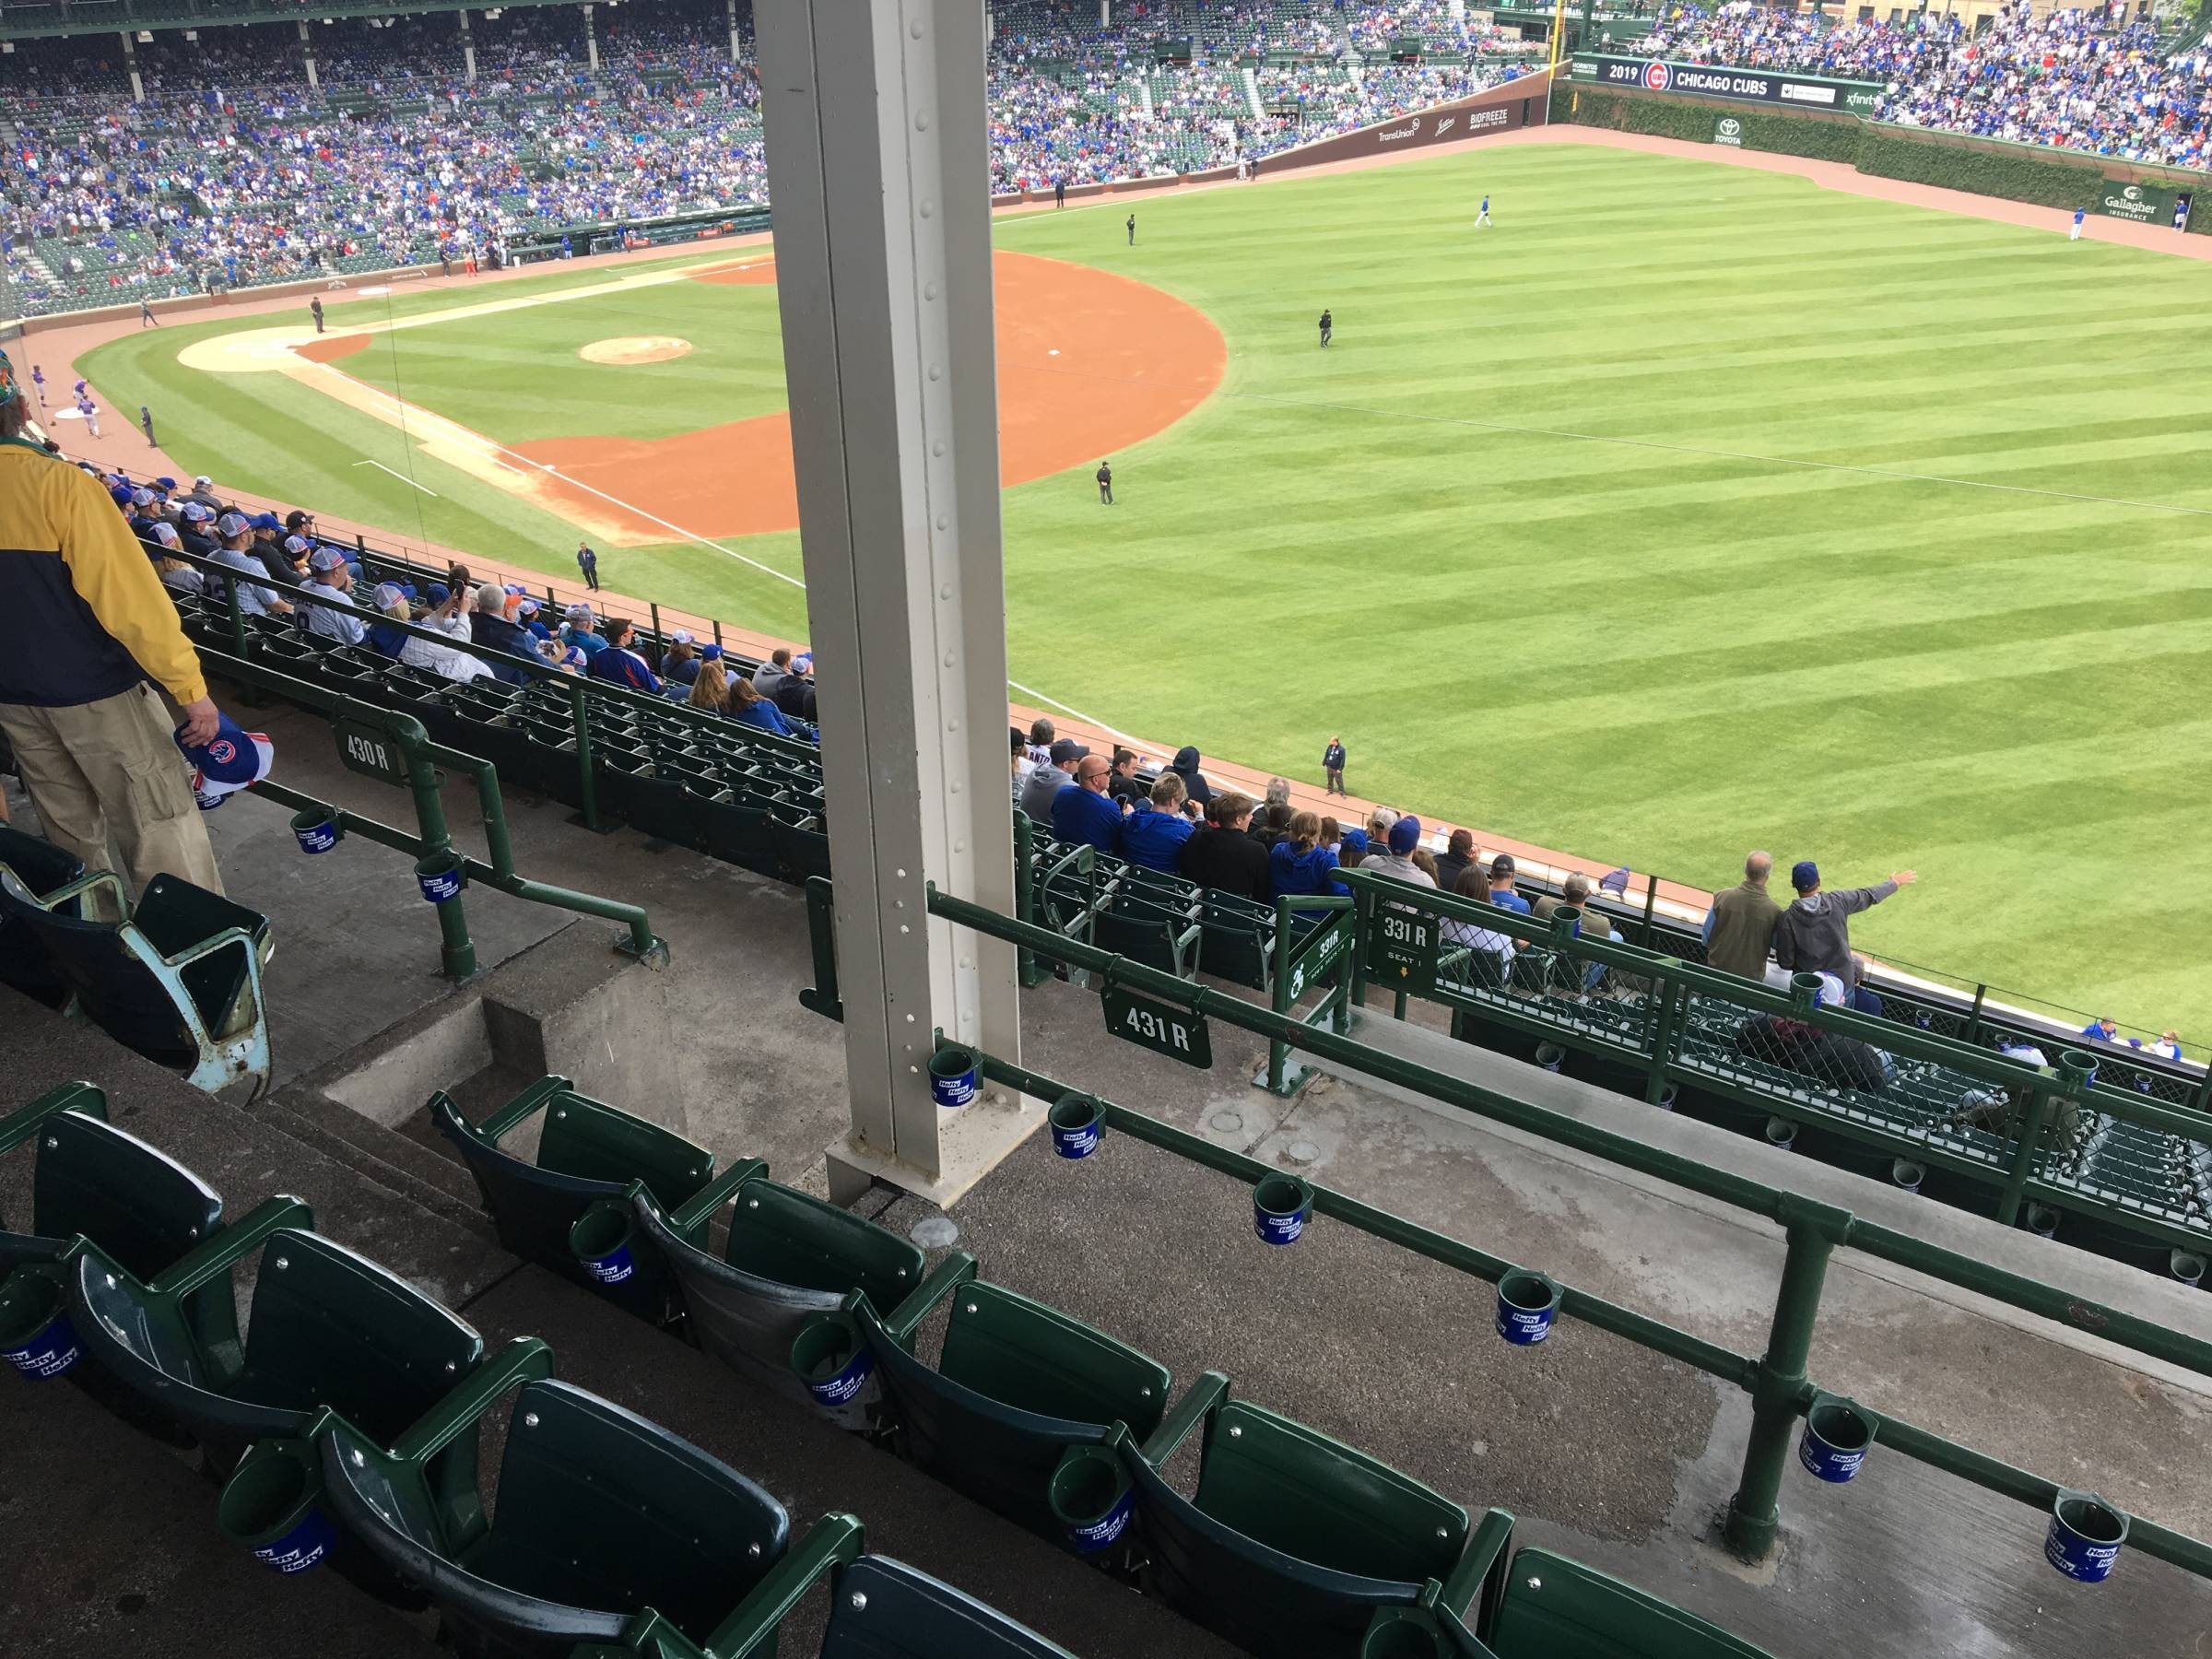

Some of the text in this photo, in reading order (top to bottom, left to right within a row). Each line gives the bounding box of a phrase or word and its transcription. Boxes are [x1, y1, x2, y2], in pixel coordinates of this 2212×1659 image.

[1609, 65, 1638, 80] 2019
[1677, 72, 1730, 91] CHICAGO
[1733, 78, 1768, 95] CUBS
[1379, 128, 1414, 141] TransUnion
[1715, 135, 1740, 145] TOYOTA
[2105, 196, 2157, 214] Gallagher
[2109, 209, 2147, 221] INSURANCE
[347, 734, 389, 771] 430 R
[1384, 916, 1427, 947] 331 R
[1387, 952, 1415, 965] SEAT
[1126, 1007, 1191, 1052] 431 R
[1514, 1314, 1538, 1323] Hefty
[42, 1349, 76, 1375] Hefty
[284, 1547, 322, 1571] Hefty
